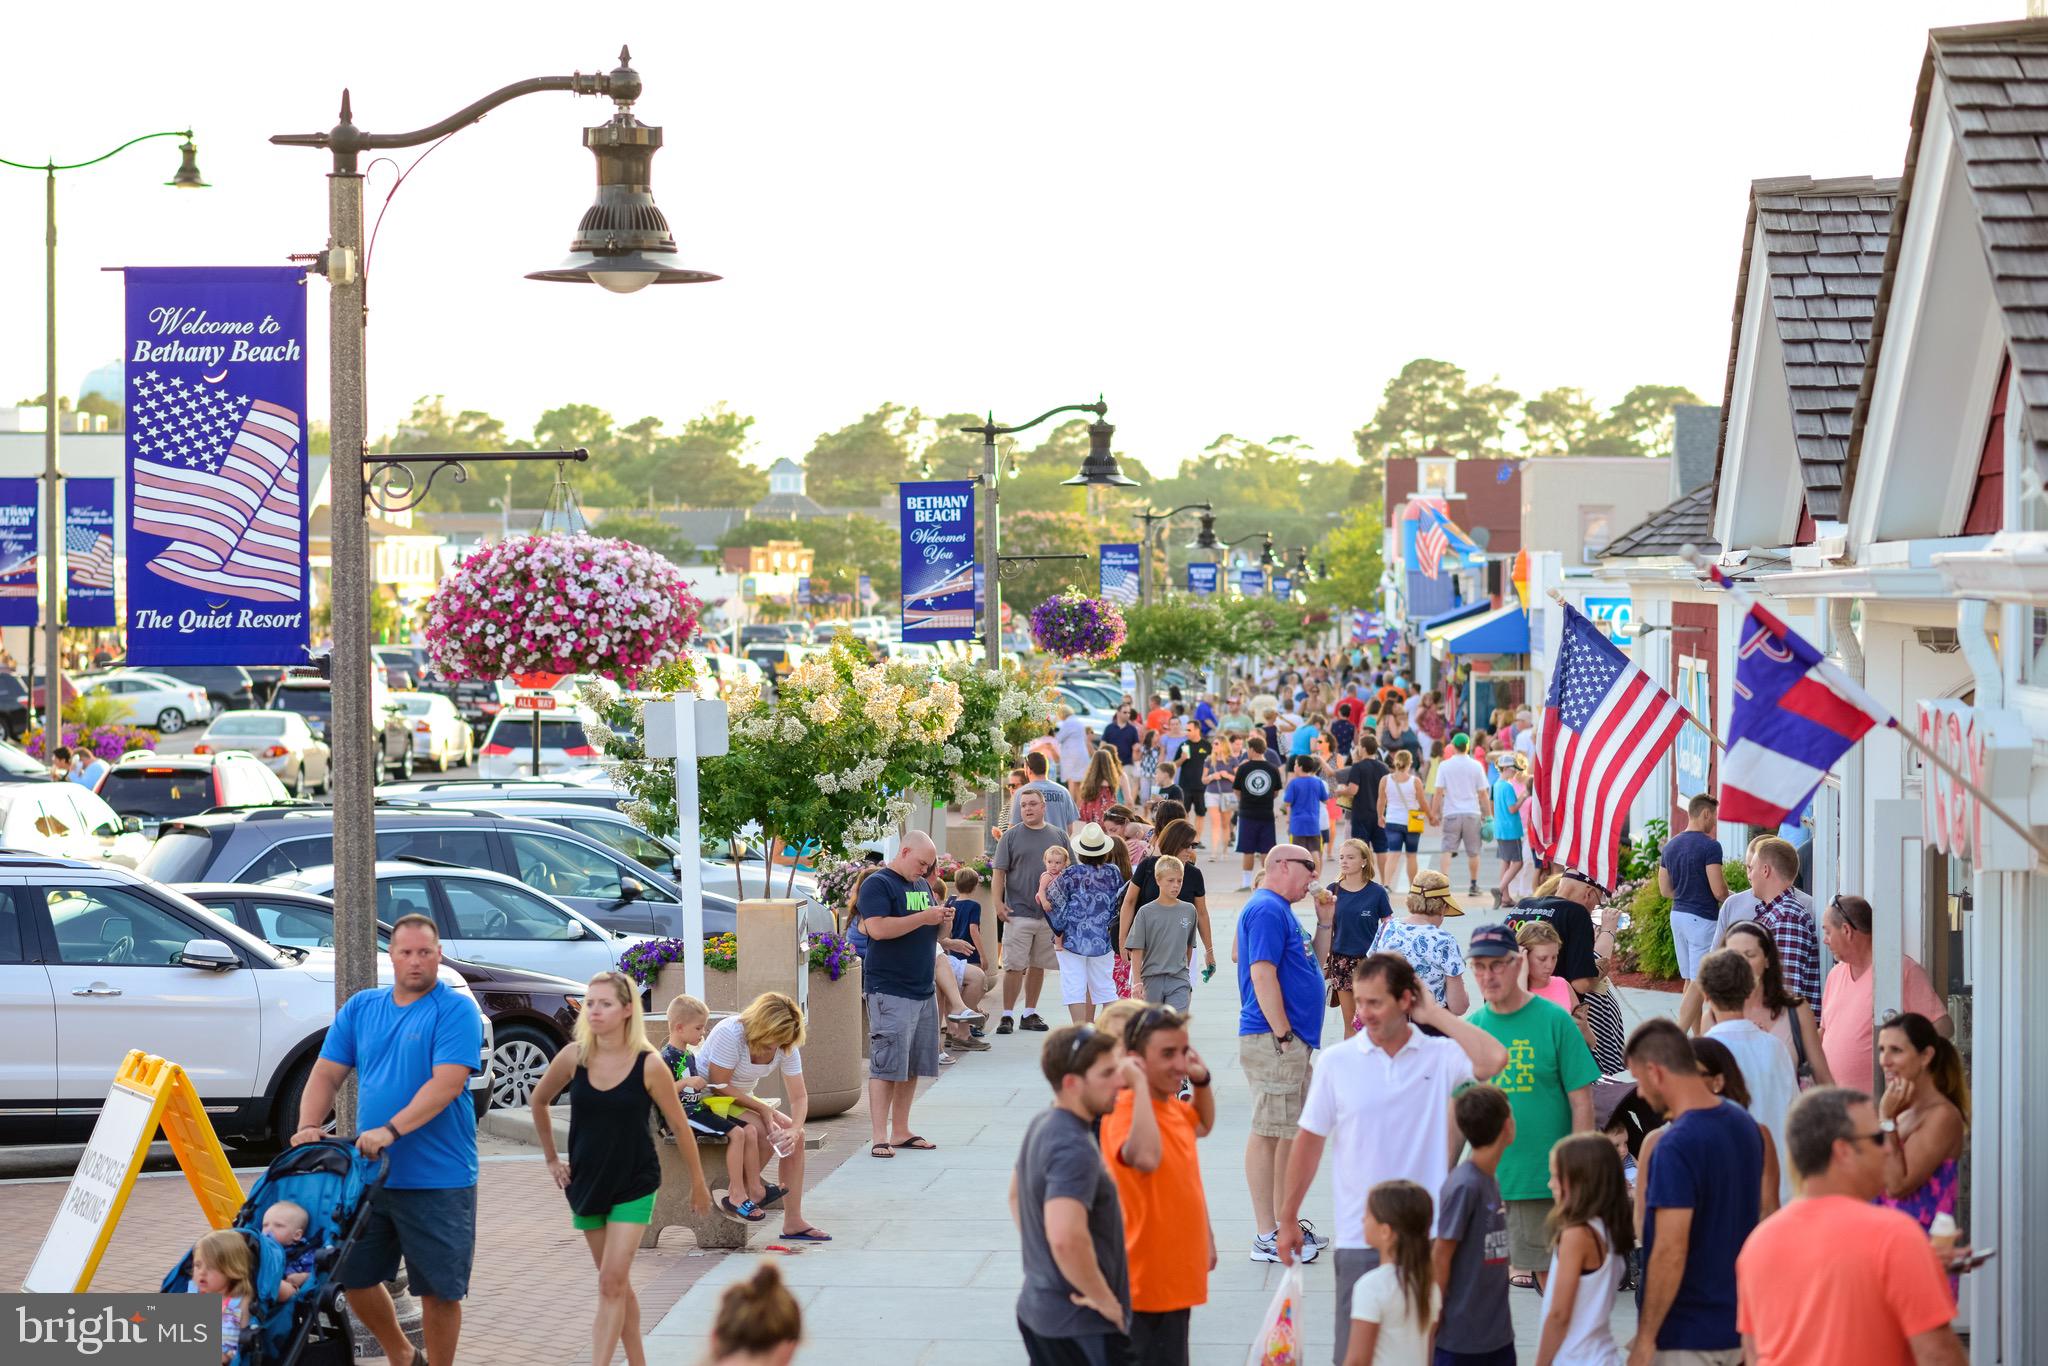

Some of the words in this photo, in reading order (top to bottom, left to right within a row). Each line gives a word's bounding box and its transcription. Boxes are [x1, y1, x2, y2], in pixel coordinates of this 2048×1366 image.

[149, 307, 254, 336] Welcome
[259, 315, 280, 334] to
[132, 340, 225, 367] Bethany
[229, 338, 300, 363] Beach
[907, 495, 969, 510] BETHANY
[915, 508, 961, 522] BEACH
[910, 528, 966, 544] Welcomes
[922, 545, 954, 565] You
[136, 609, 173, 629] The
[179, 609, 233, 633] Quiet
[237, 609, 301, 630] Resort
[517, 699, 533, 707] ALL
[537, 699, 553, 708] WAY
[80, 1150, 98, 1176] NO
[91, 1153, 126, 1189] BICYCLE
[66, 1186, 107, 1225] PARKING
